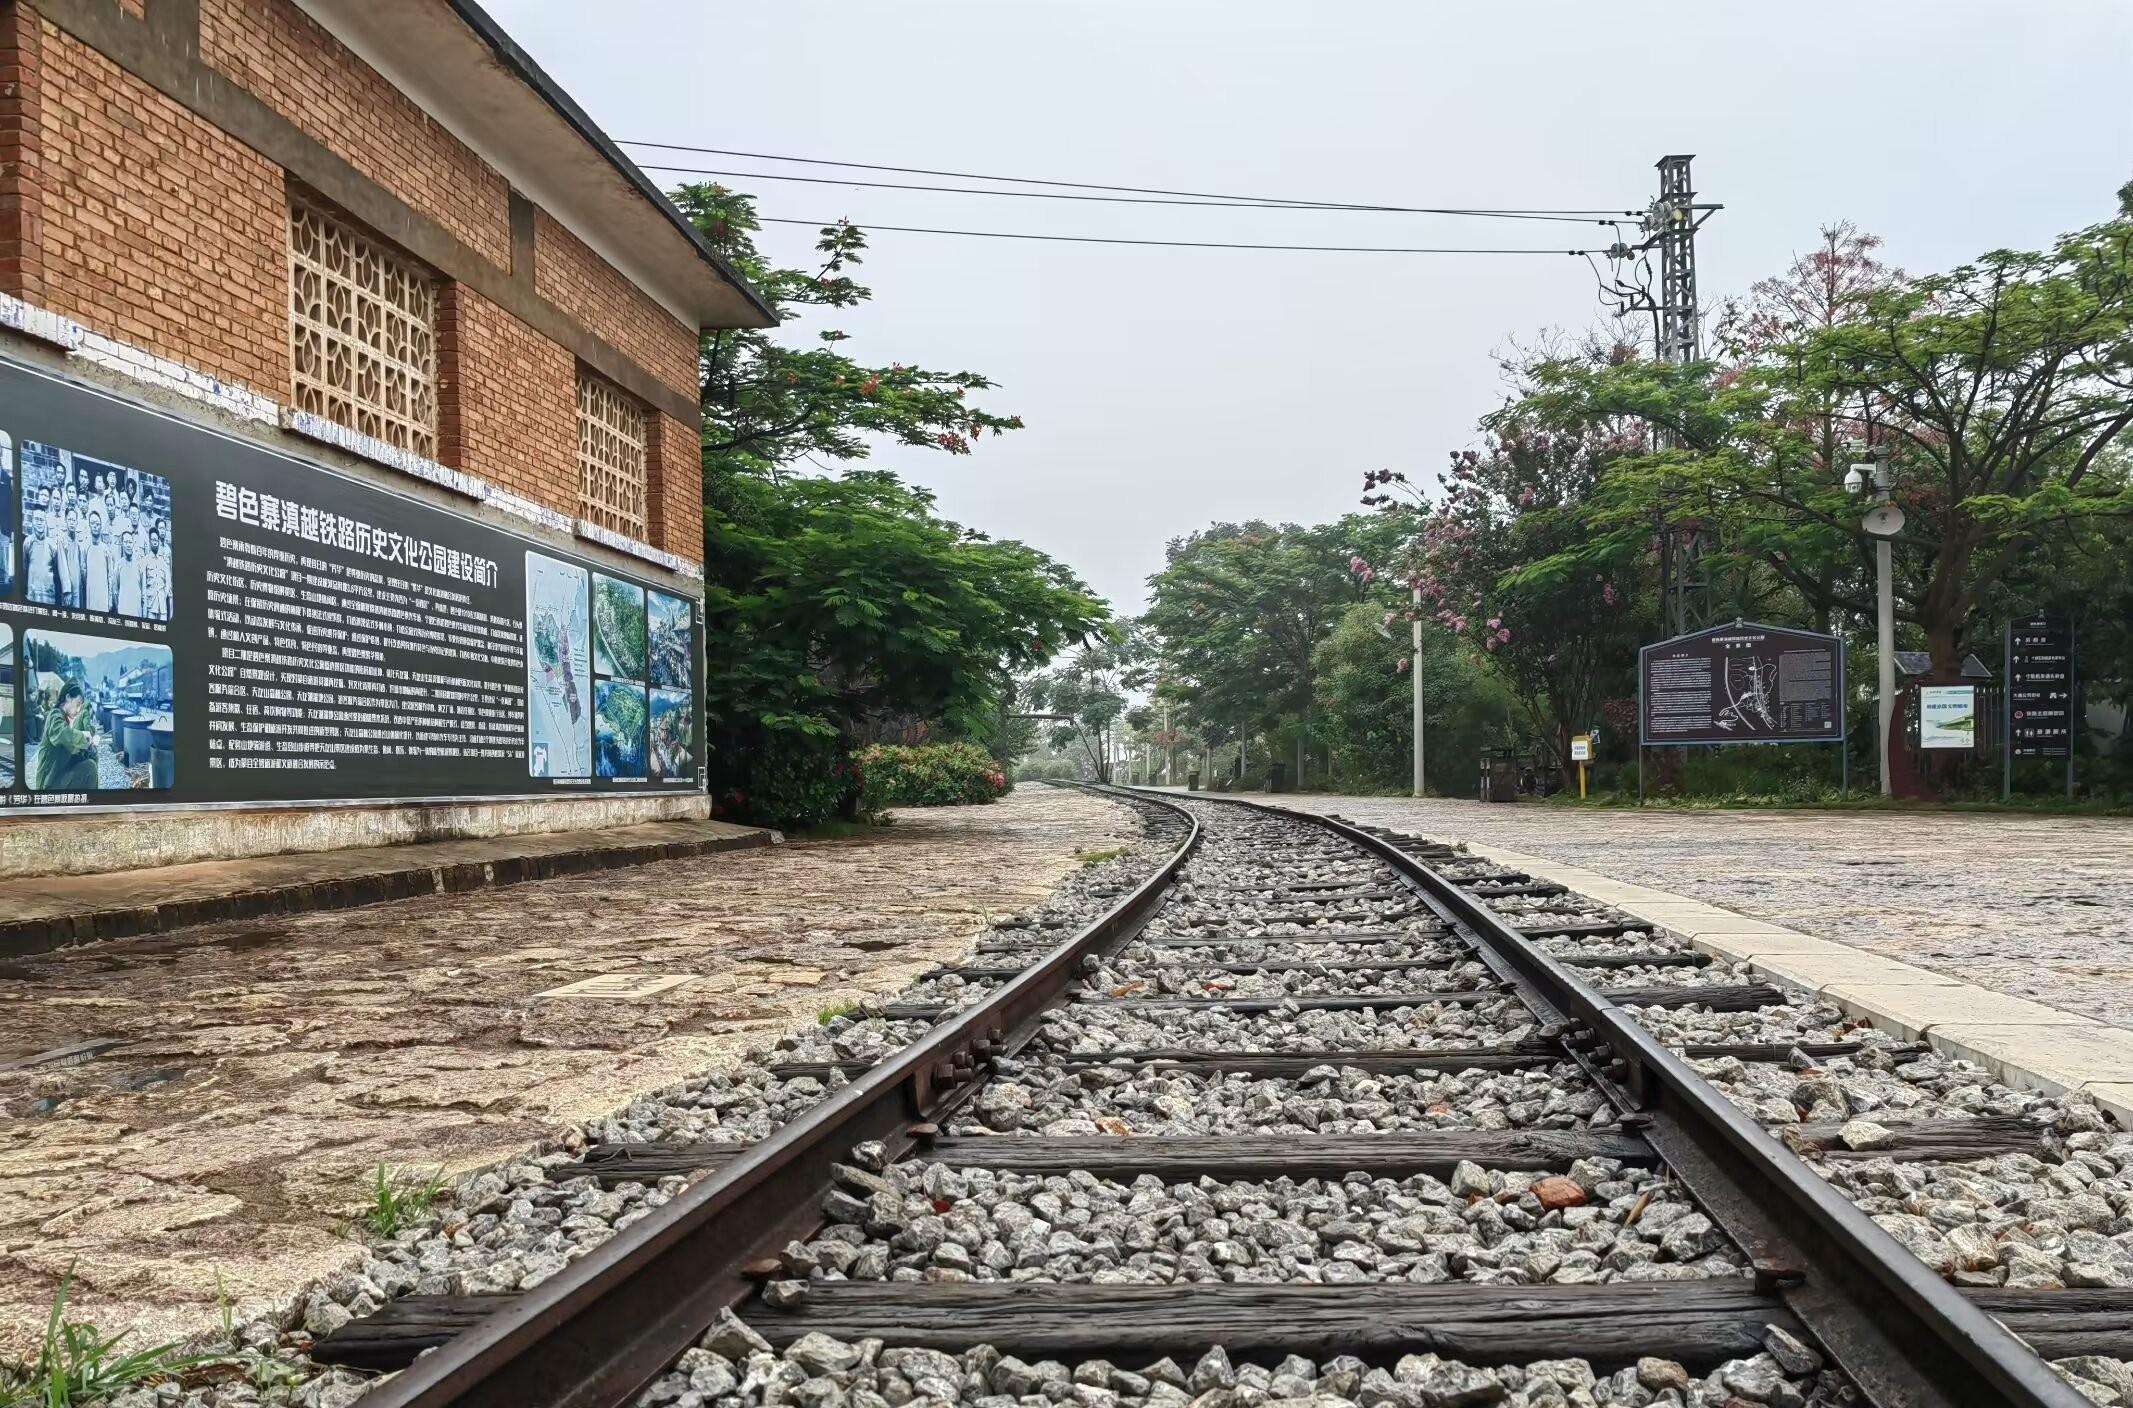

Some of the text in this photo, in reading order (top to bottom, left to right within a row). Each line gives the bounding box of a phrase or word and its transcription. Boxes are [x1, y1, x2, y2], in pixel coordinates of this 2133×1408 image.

[215, 480, 498, 589] 碧色寨滇越铁路历史文化公园建设简介
